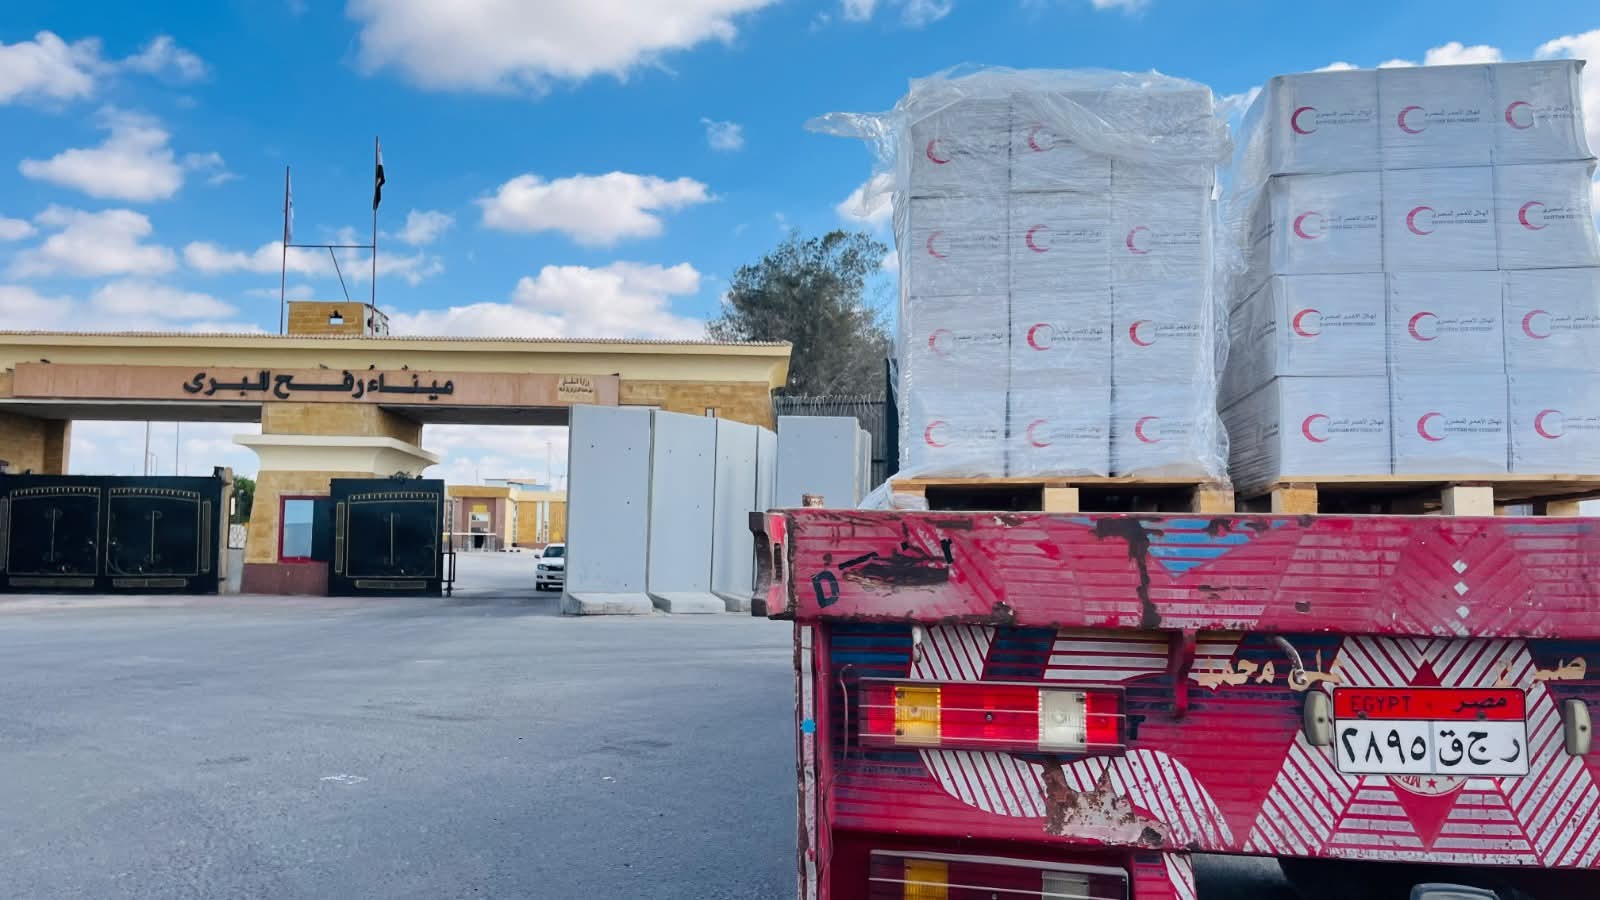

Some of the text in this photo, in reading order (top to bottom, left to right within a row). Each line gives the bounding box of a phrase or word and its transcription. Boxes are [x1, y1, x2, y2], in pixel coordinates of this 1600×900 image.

[274, 369, 364, 400] رفح
[366, 372, 455, 400] ميناء
[1351, 695, 1412, 713] EGYPT
[1454, 696, 1508, 712] مصر
